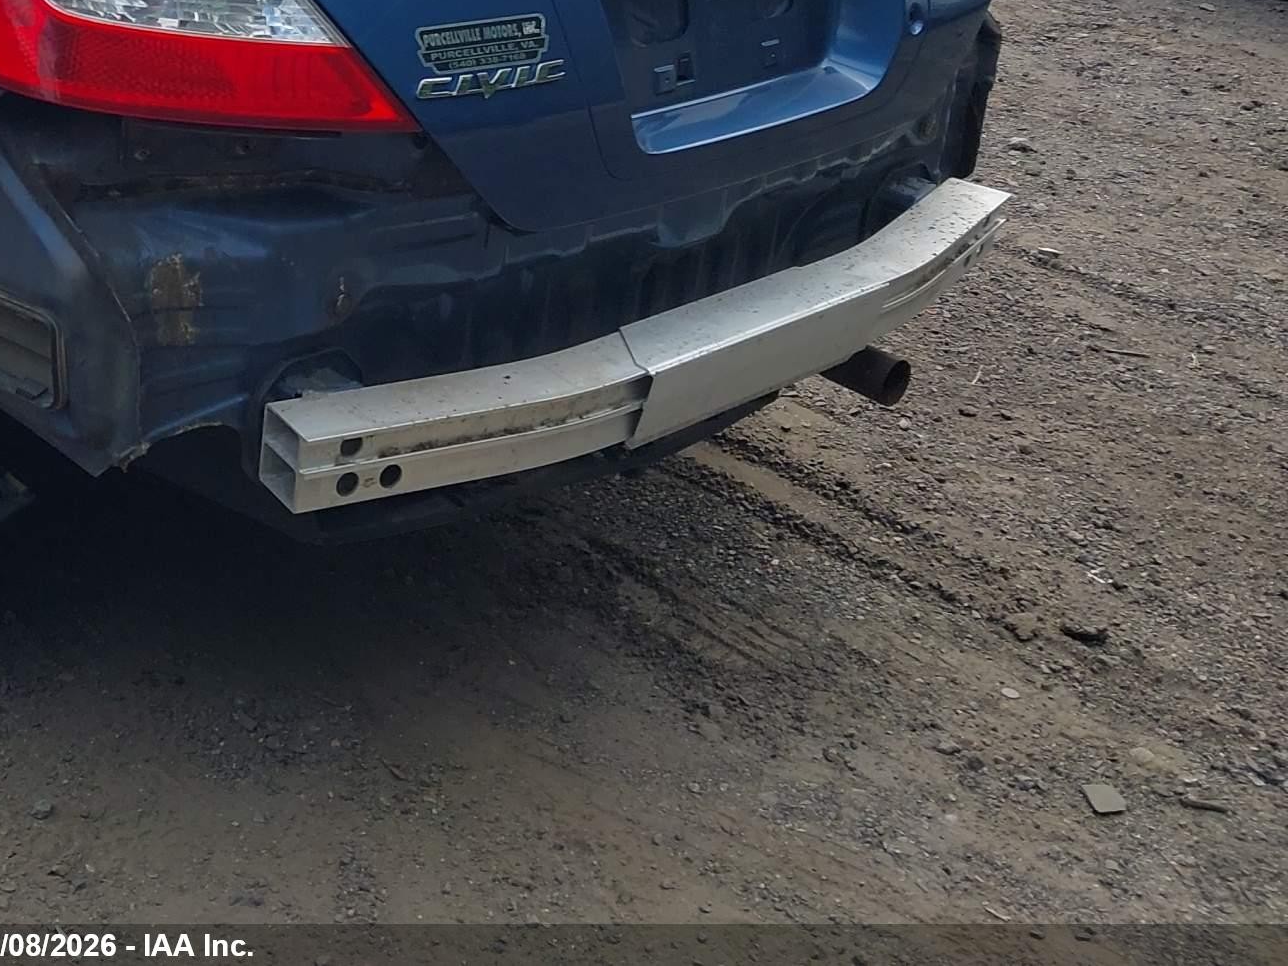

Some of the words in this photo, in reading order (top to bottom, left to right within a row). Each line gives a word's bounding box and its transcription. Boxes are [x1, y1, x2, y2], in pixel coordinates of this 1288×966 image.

[423, 27, 482, 48] PURCELLVILLE
[431, 44, 519, 61] PURCELLVILLE,
[416, 59, 566, 99] CIVIC
